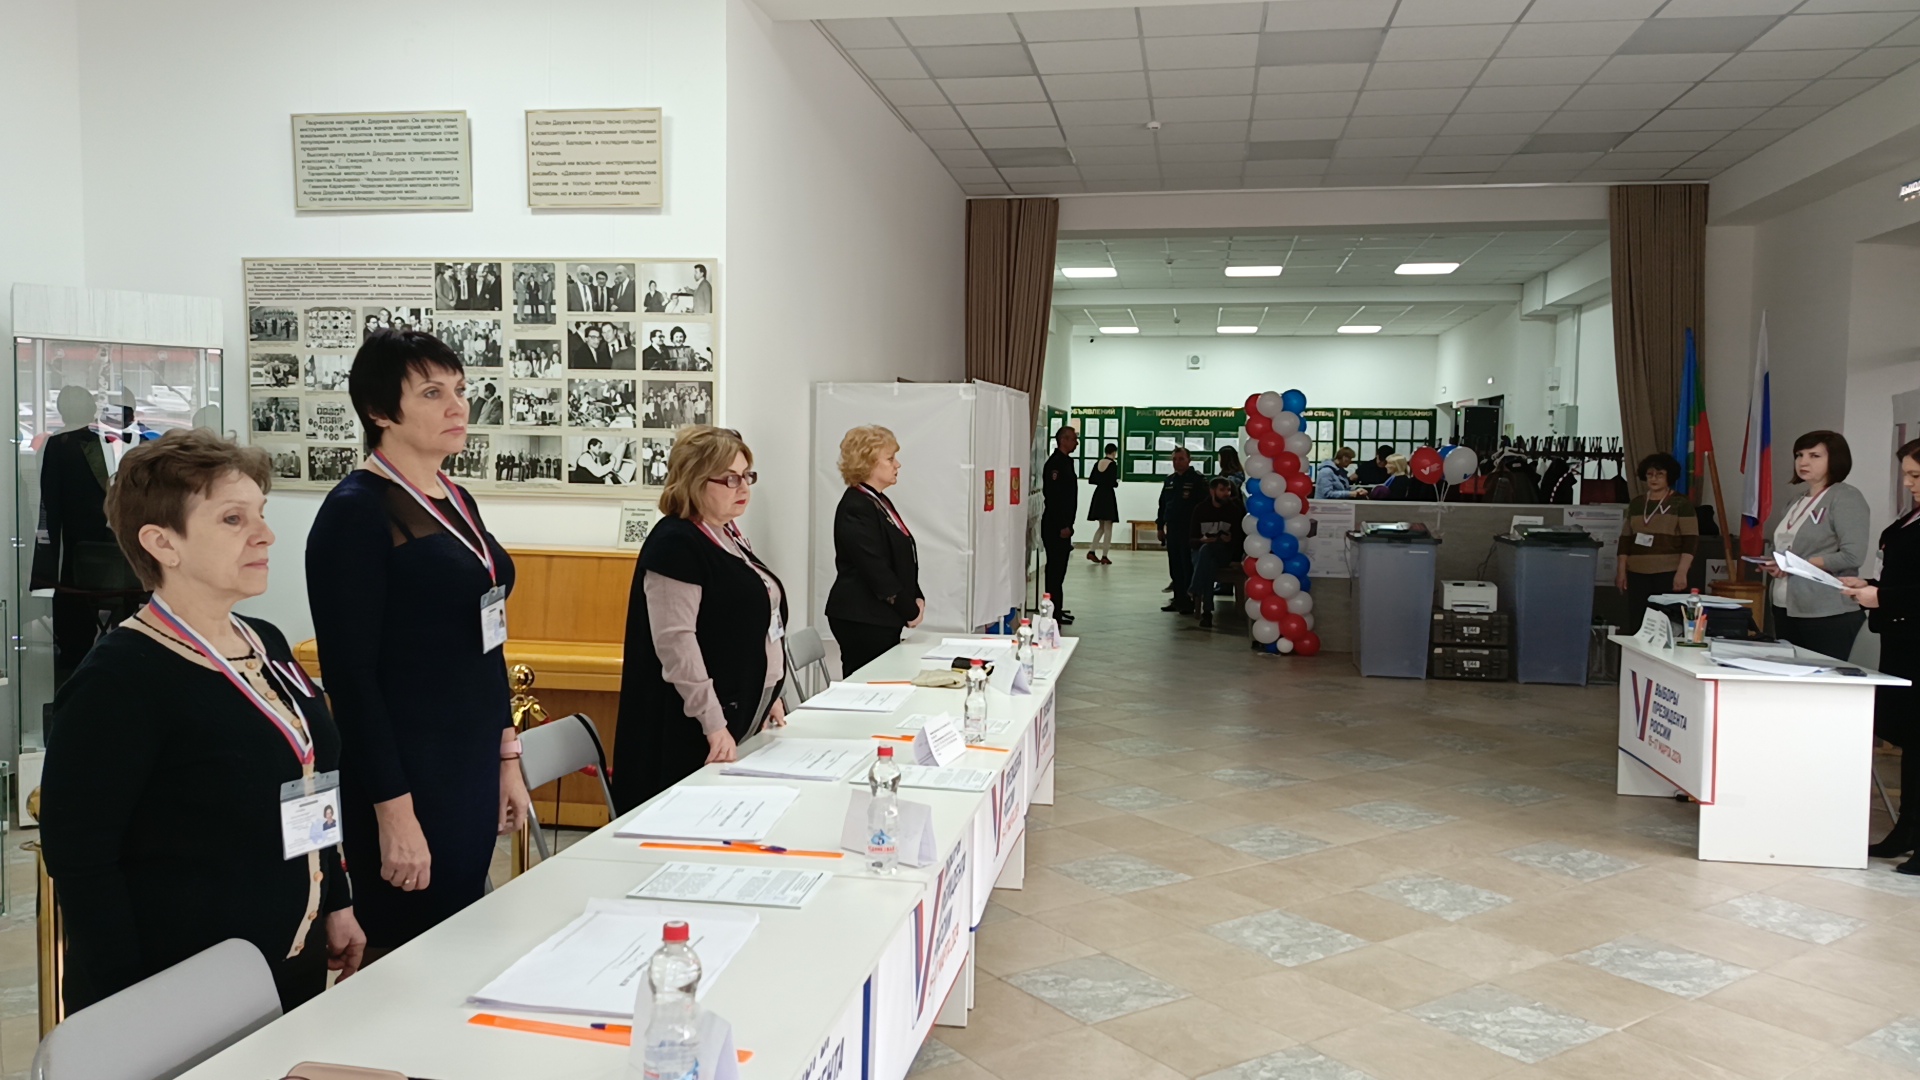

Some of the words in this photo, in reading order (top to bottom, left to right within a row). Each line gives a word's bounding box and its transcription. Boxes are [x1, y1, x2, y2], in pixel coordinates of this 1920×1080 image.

[1071, 407, 1116, 415] БЪЯВЛЕНИЙ
[1160, 418, 1210, 426] СТУДЕНТОВ
[1655, 683, 1680, 706] ВЫБОРЫ
[1652, 700, 1687, 731] ПРЕЗИДЕНТА
[1649, 718, 1672, 741] РОССИИ
